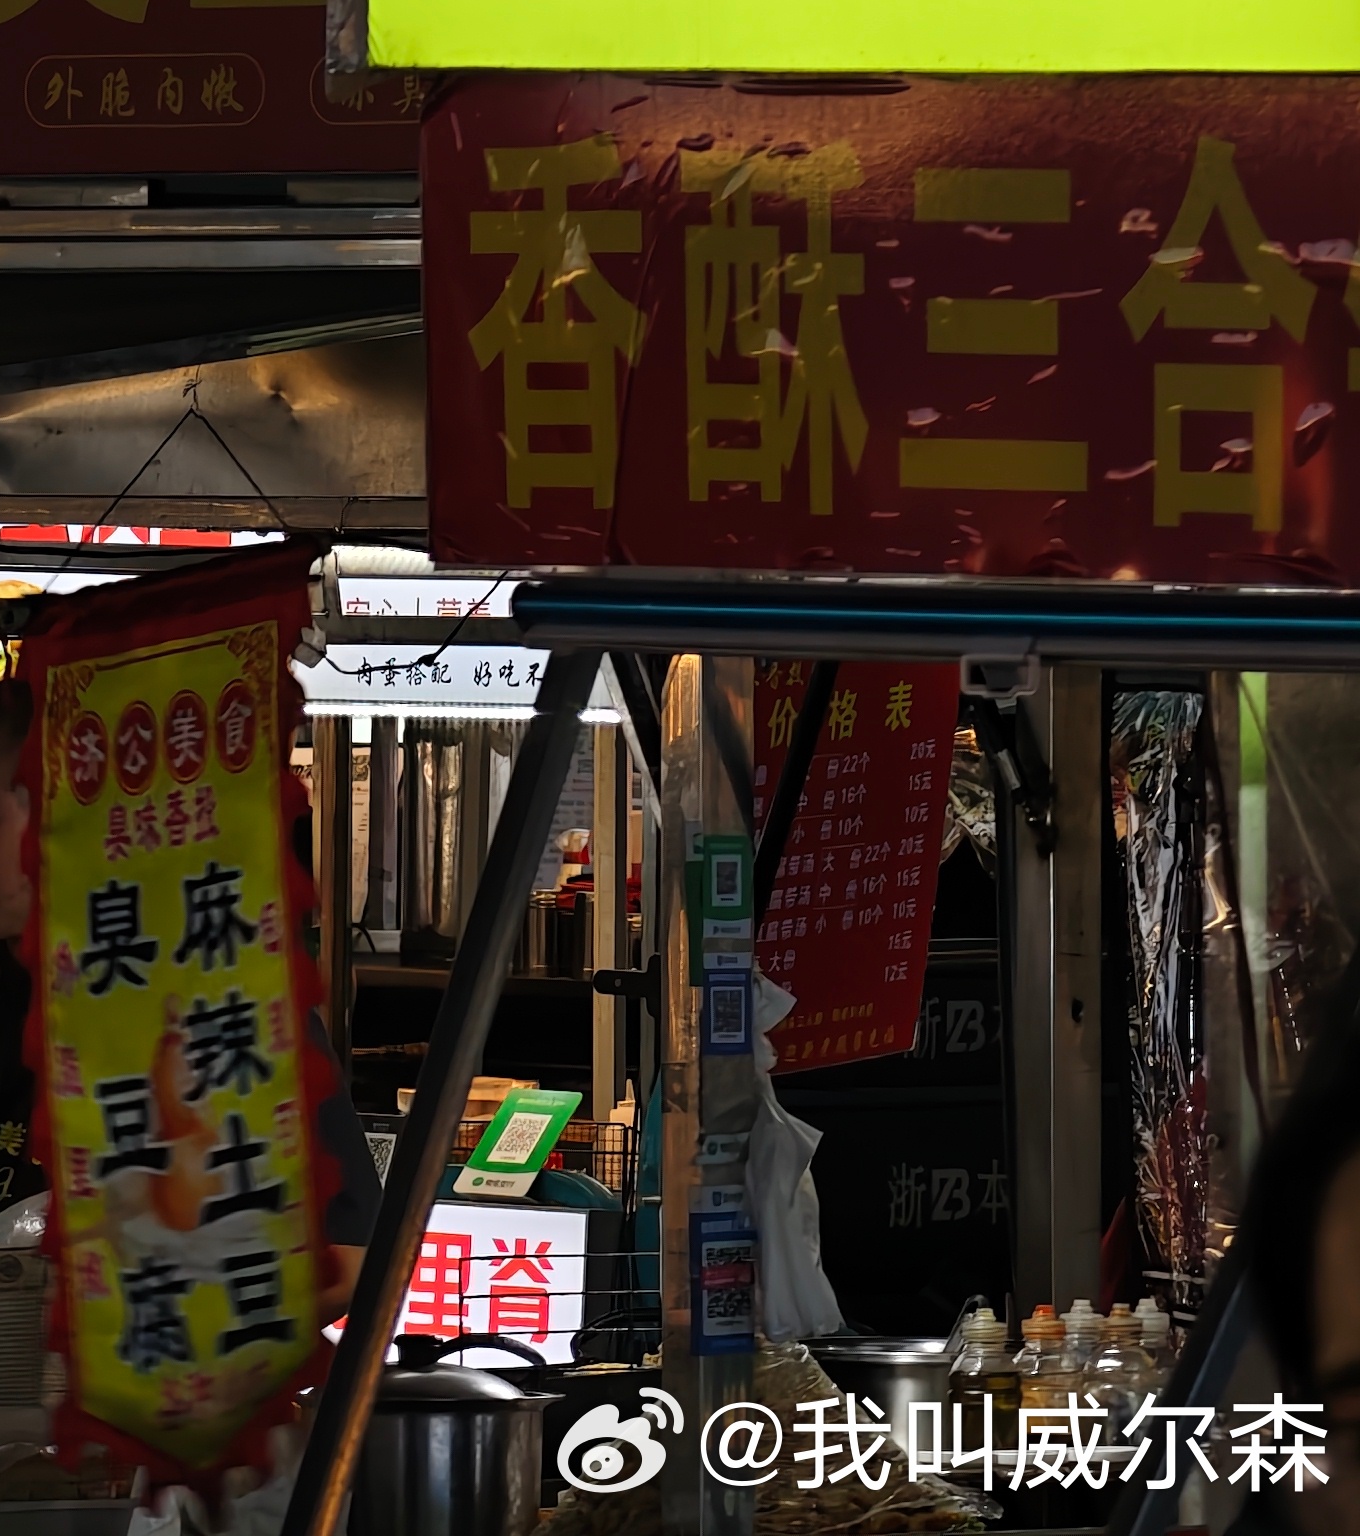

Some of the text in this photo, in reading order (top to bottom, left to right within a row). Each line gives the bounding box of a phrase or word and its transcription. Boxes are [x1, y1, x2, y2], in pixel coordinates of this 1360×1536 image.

[468, 132, 1360, 532] 香酥三合
[70, 699, 253, 782] 济公美食
[767, 680, 914, 749] 价格表
